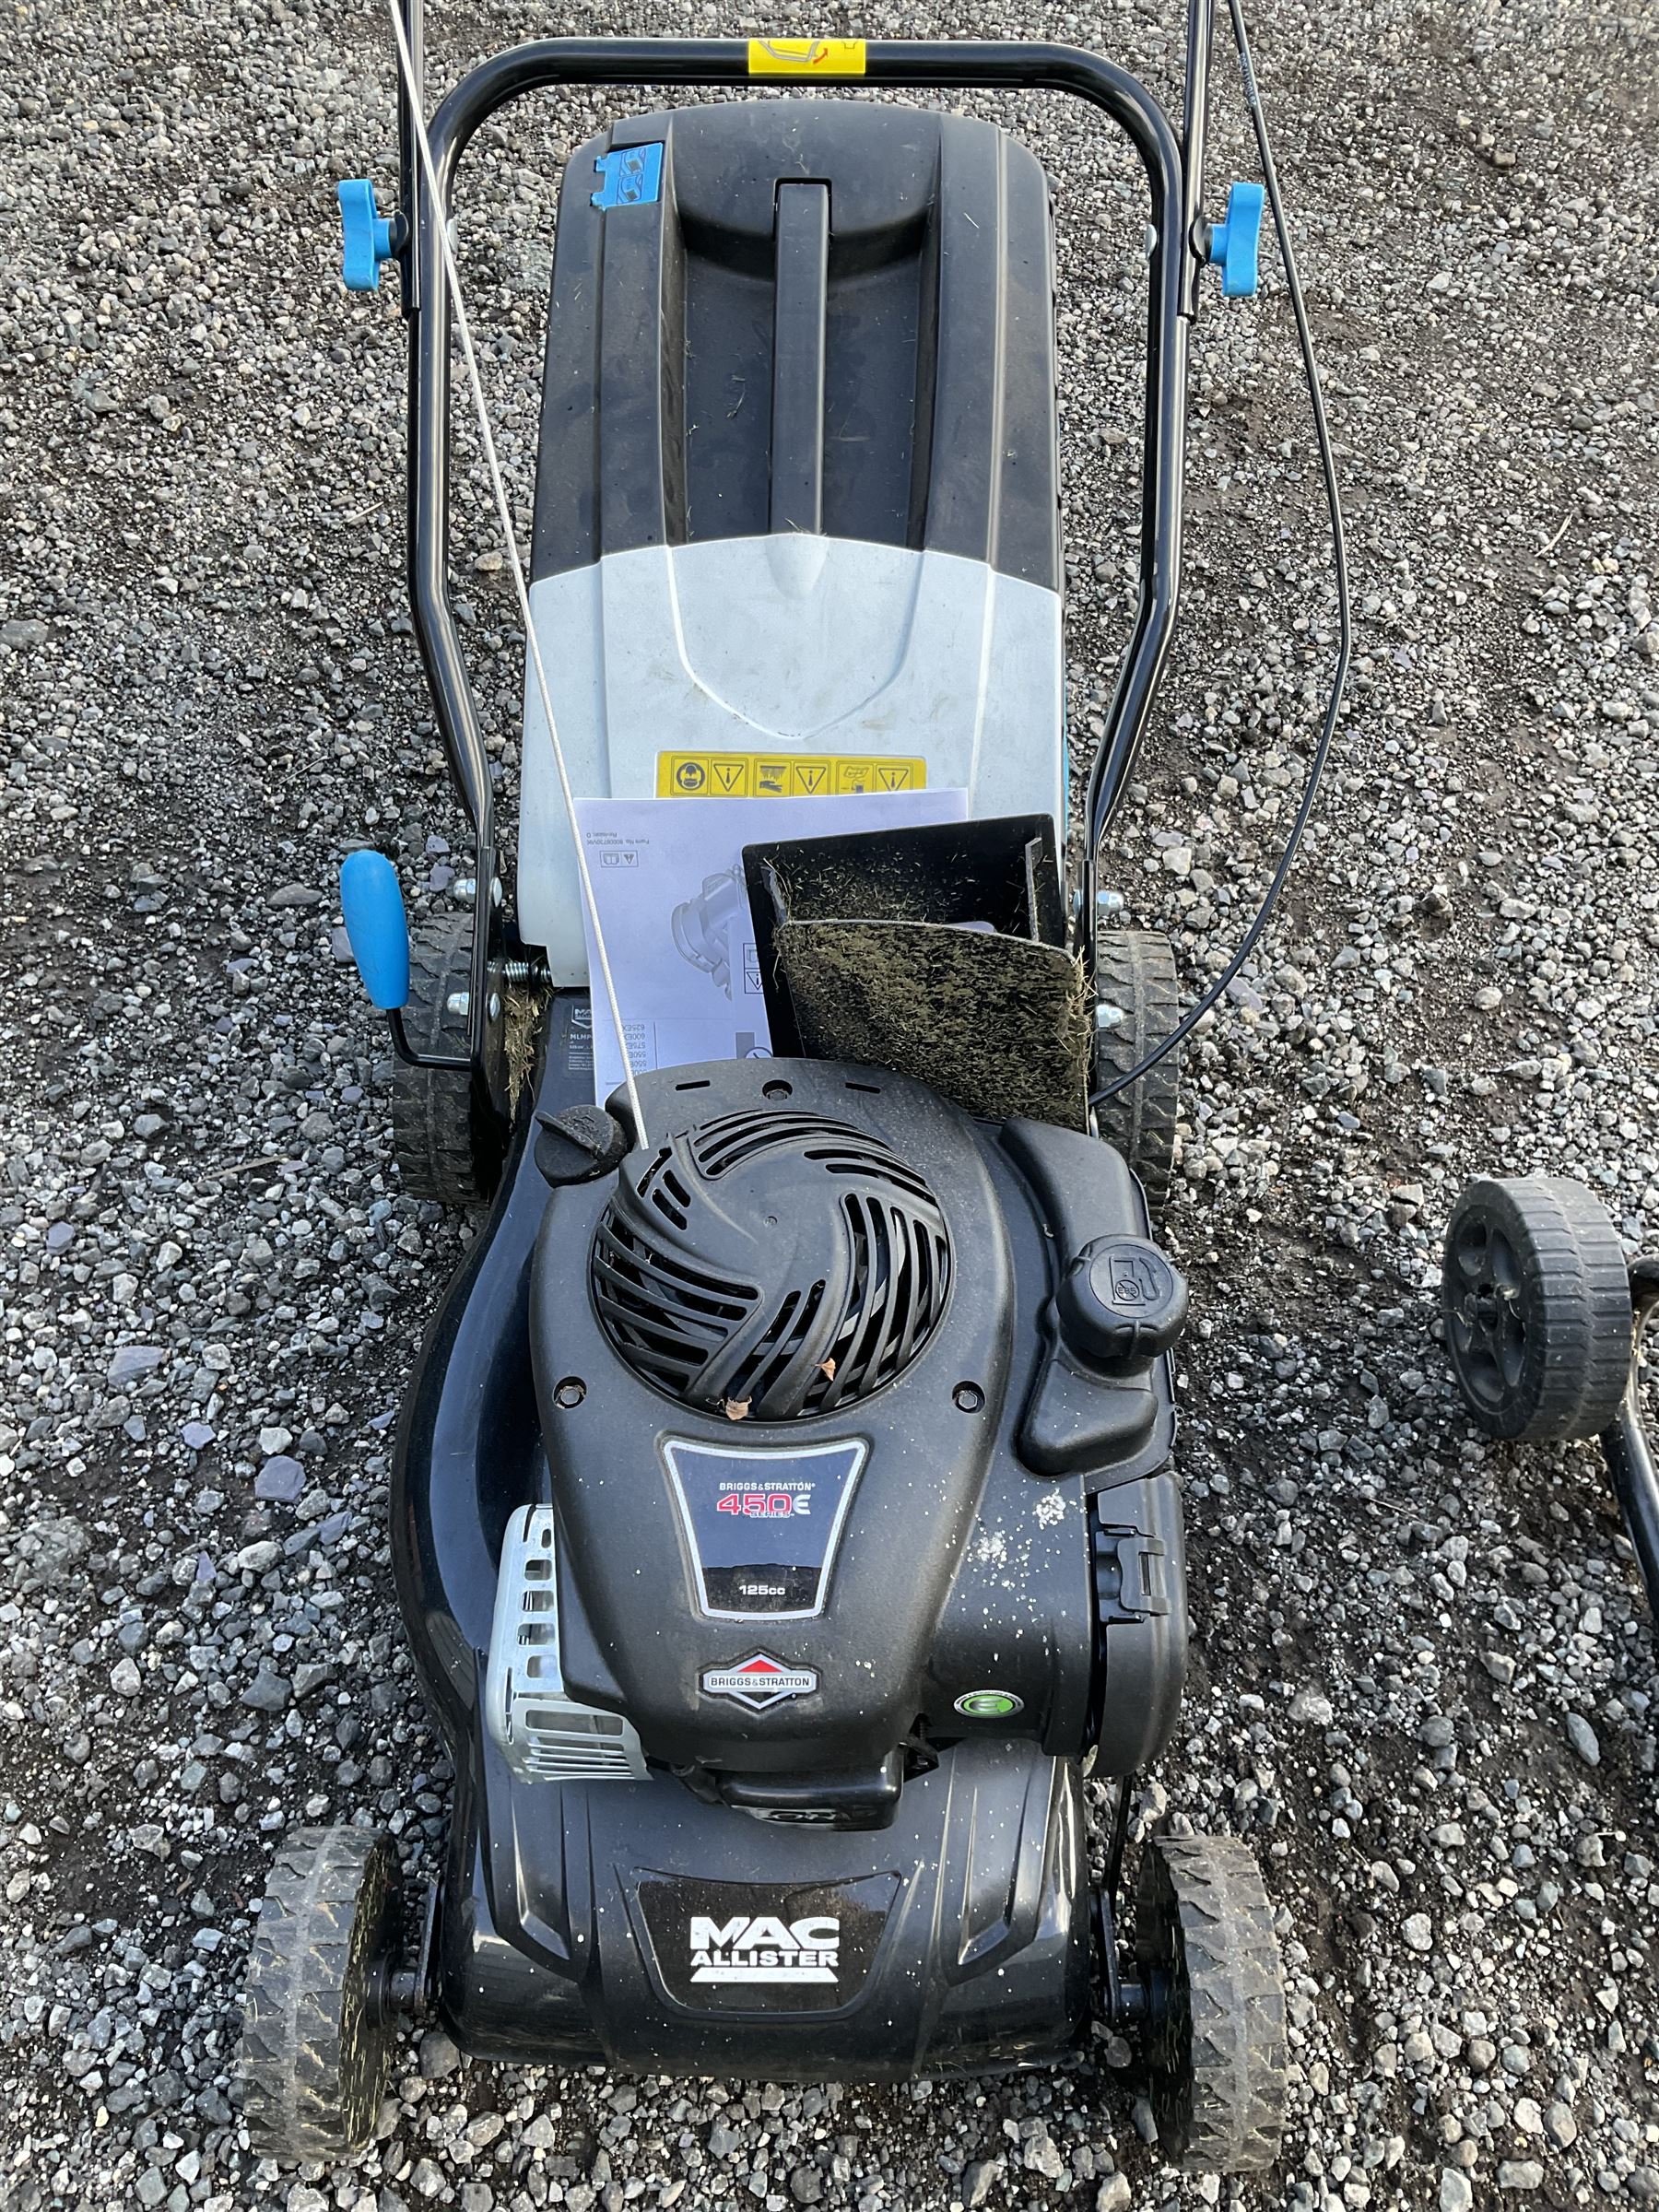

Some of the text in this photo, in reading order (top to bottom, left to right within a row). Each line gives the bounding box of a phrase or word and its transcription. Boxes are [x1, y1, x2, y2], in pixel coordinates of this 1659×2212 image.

[738, 1584, 786, 1595] 125cc
[710, 1677, 809, 1688] BRIGGS&STRATTON
[689, 1916, 840, 1949] MAC
[689, 1950, 839, 1967] ALLISTER
